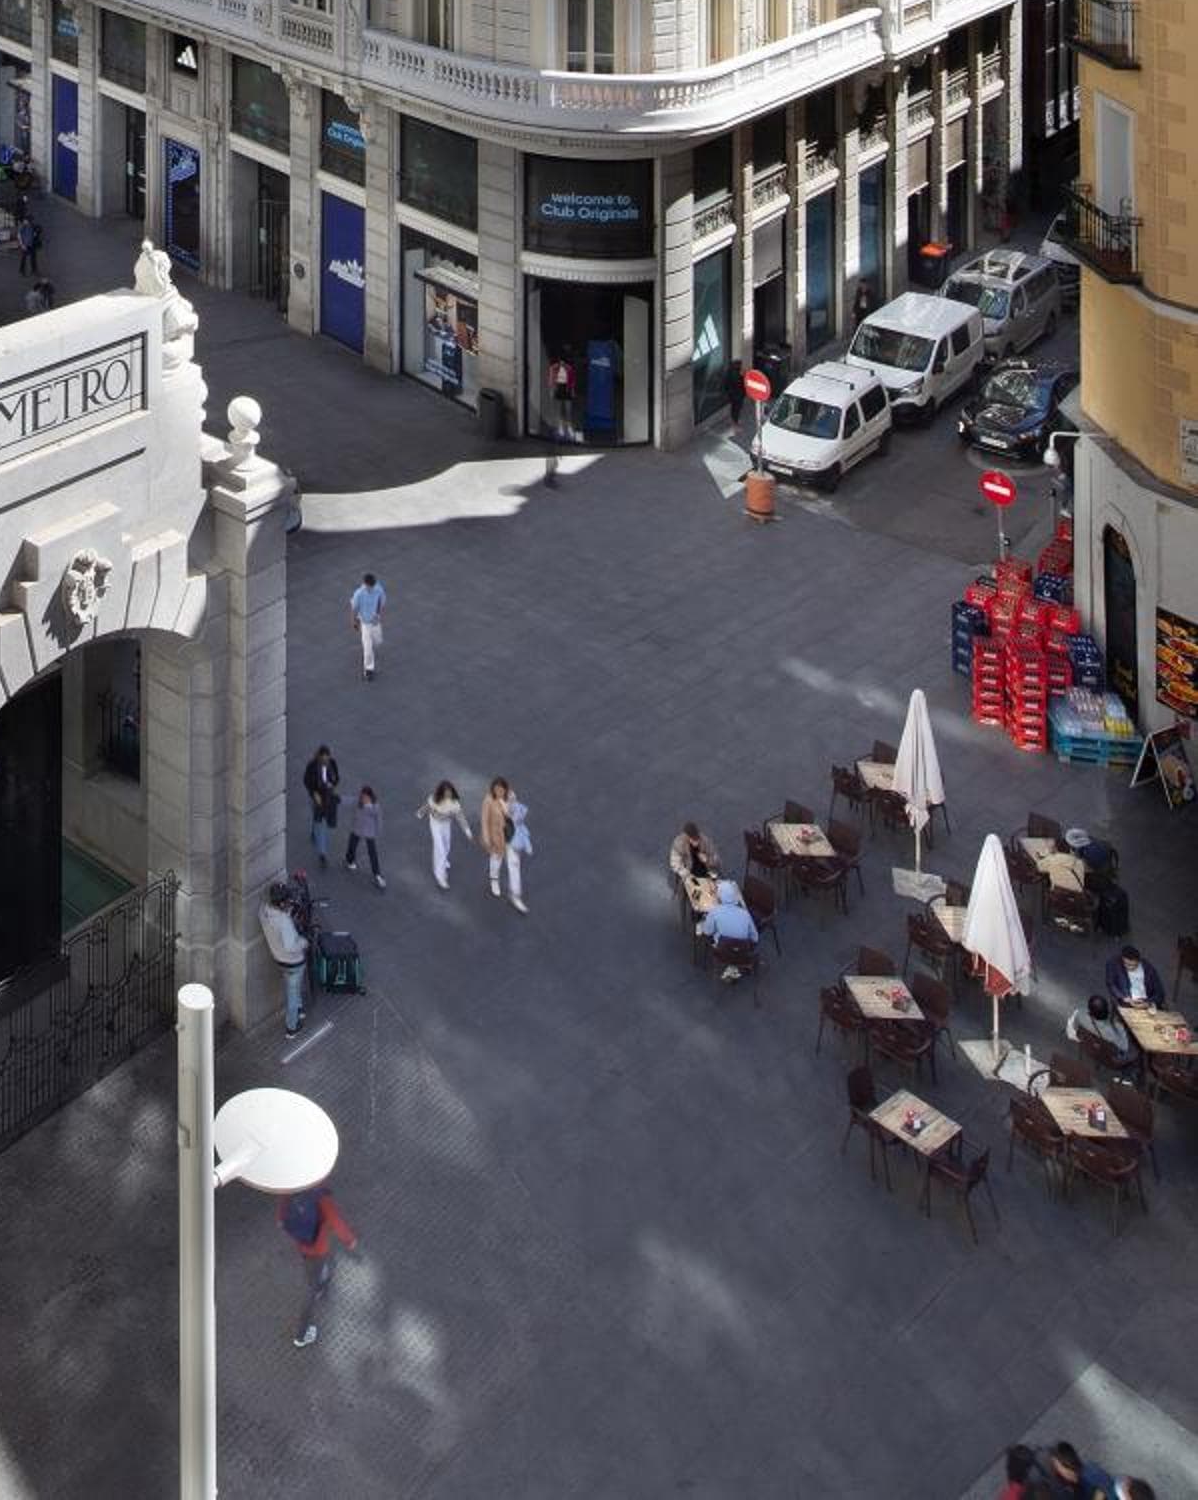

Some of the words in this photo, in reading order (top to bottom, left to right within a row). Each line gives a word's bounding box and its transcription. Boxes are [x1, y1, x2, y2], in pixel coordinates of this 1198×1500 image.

[550, 192, 615, 205] welcome
[617, 195, 632, 205] to
[541, 203, 575, 217] Club
